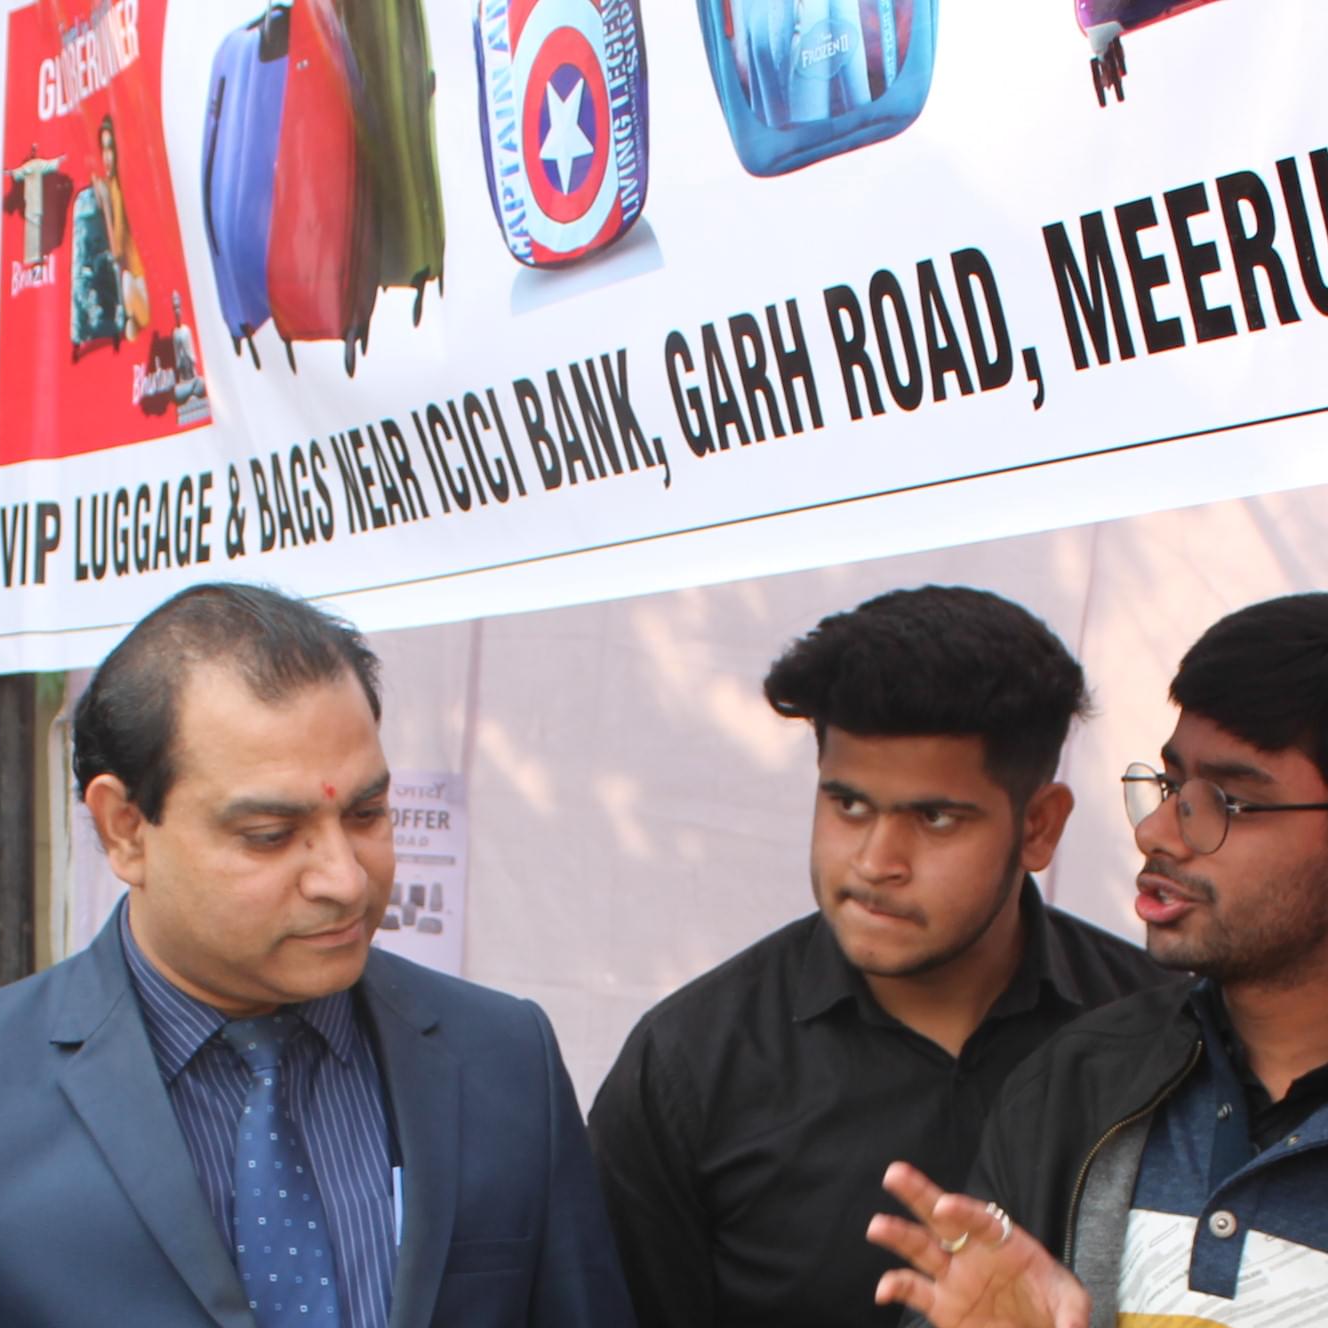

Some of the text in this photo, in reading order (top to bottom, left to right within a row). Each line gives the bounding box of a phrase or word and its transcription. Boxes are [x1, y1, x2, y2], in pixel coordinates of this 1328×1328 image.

[0, 501, 61, 588] VIP
[74, 471, 213, 583] LUGGAGE
[223, 461, 246, 560] &
[250, 438, 335, 553] BAGS
[329, 418, 430, 536] NEAR
[410, 387, 528, 515] ICICI
[512, 348, 671, 489] BANK,
[664, 297, 825, 458] GARH
[823, 246, 1045, 411] ROAD,
